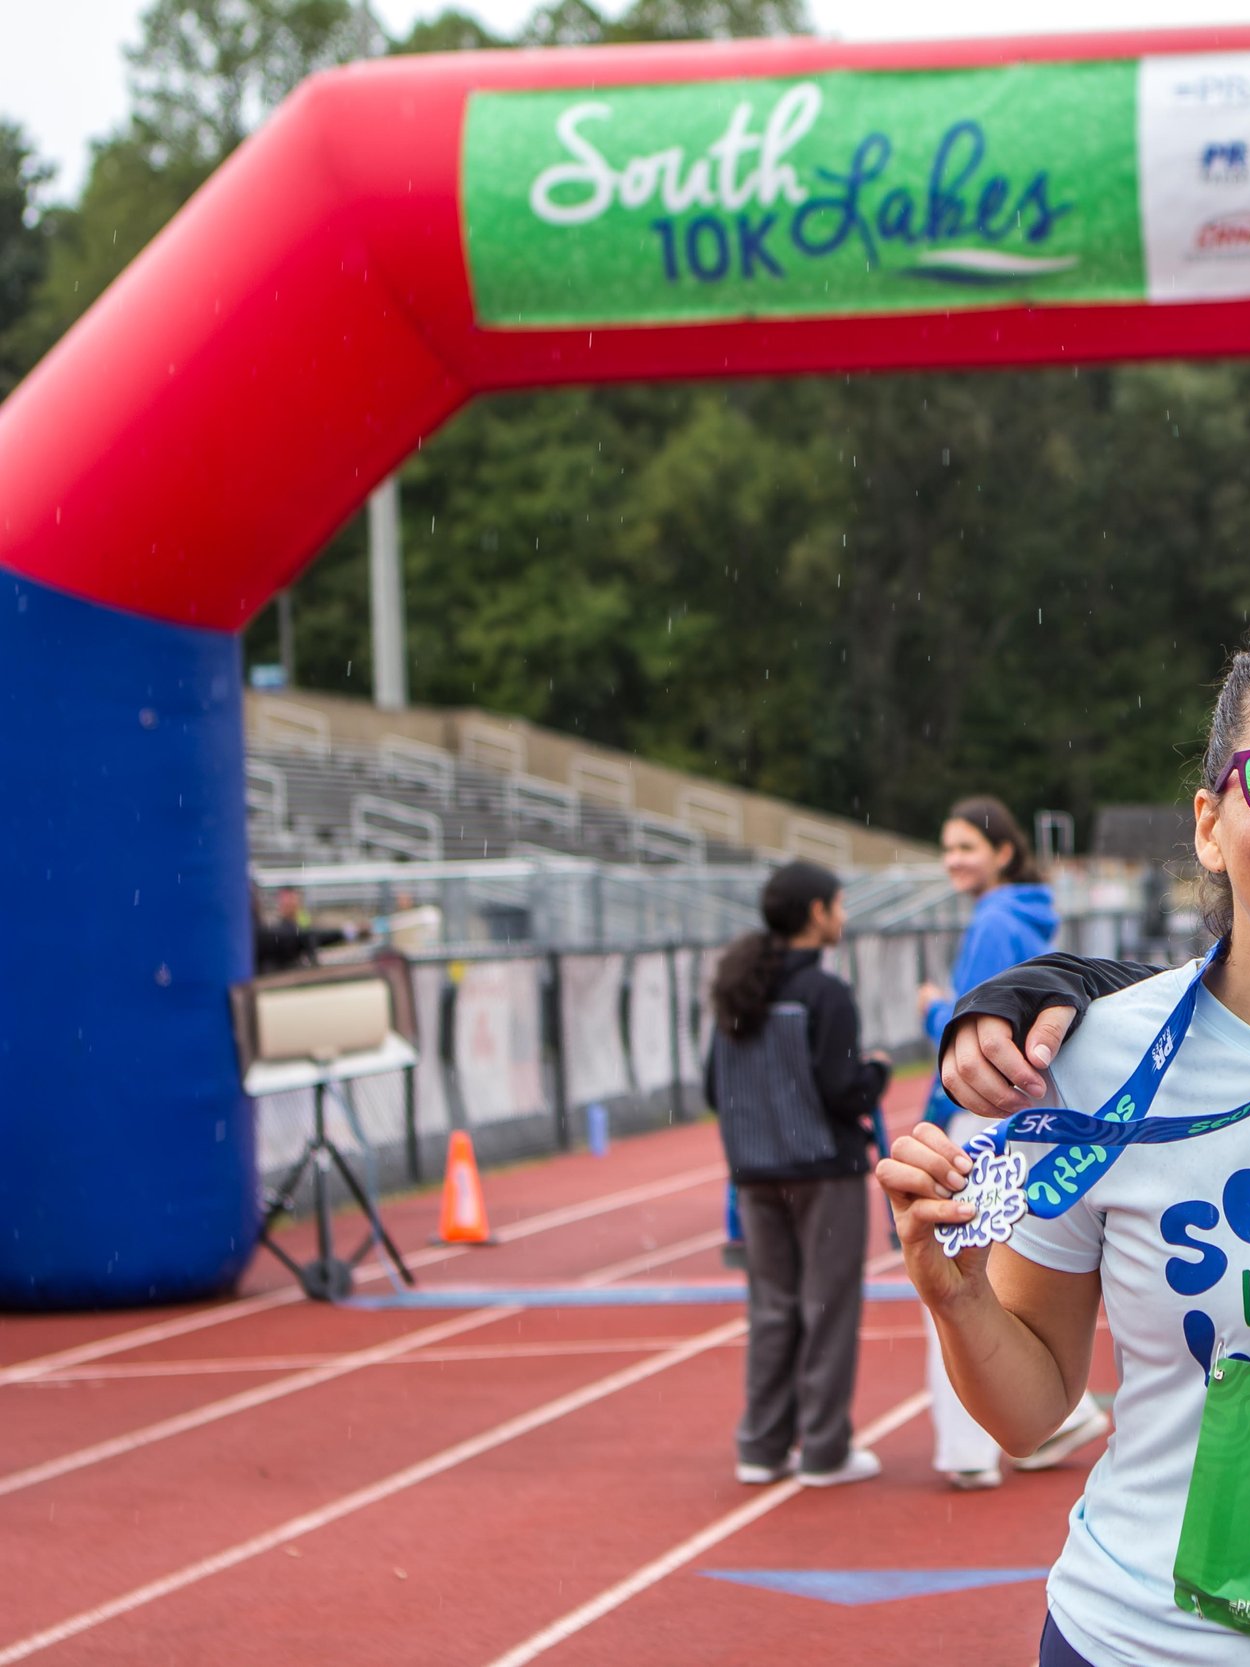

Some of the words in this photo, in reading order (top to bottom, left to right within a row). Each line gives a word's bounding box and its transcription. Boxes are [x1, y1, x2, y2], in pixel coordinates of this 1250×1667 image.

[529, 83, 823, 226] South
[790, 120, 1075, 269] Lakes
[651, 214, 783, 284] 10K
[1014, 1114, 1059, 1135] 5K
[972, 1155, 1022, 1190] UTH
